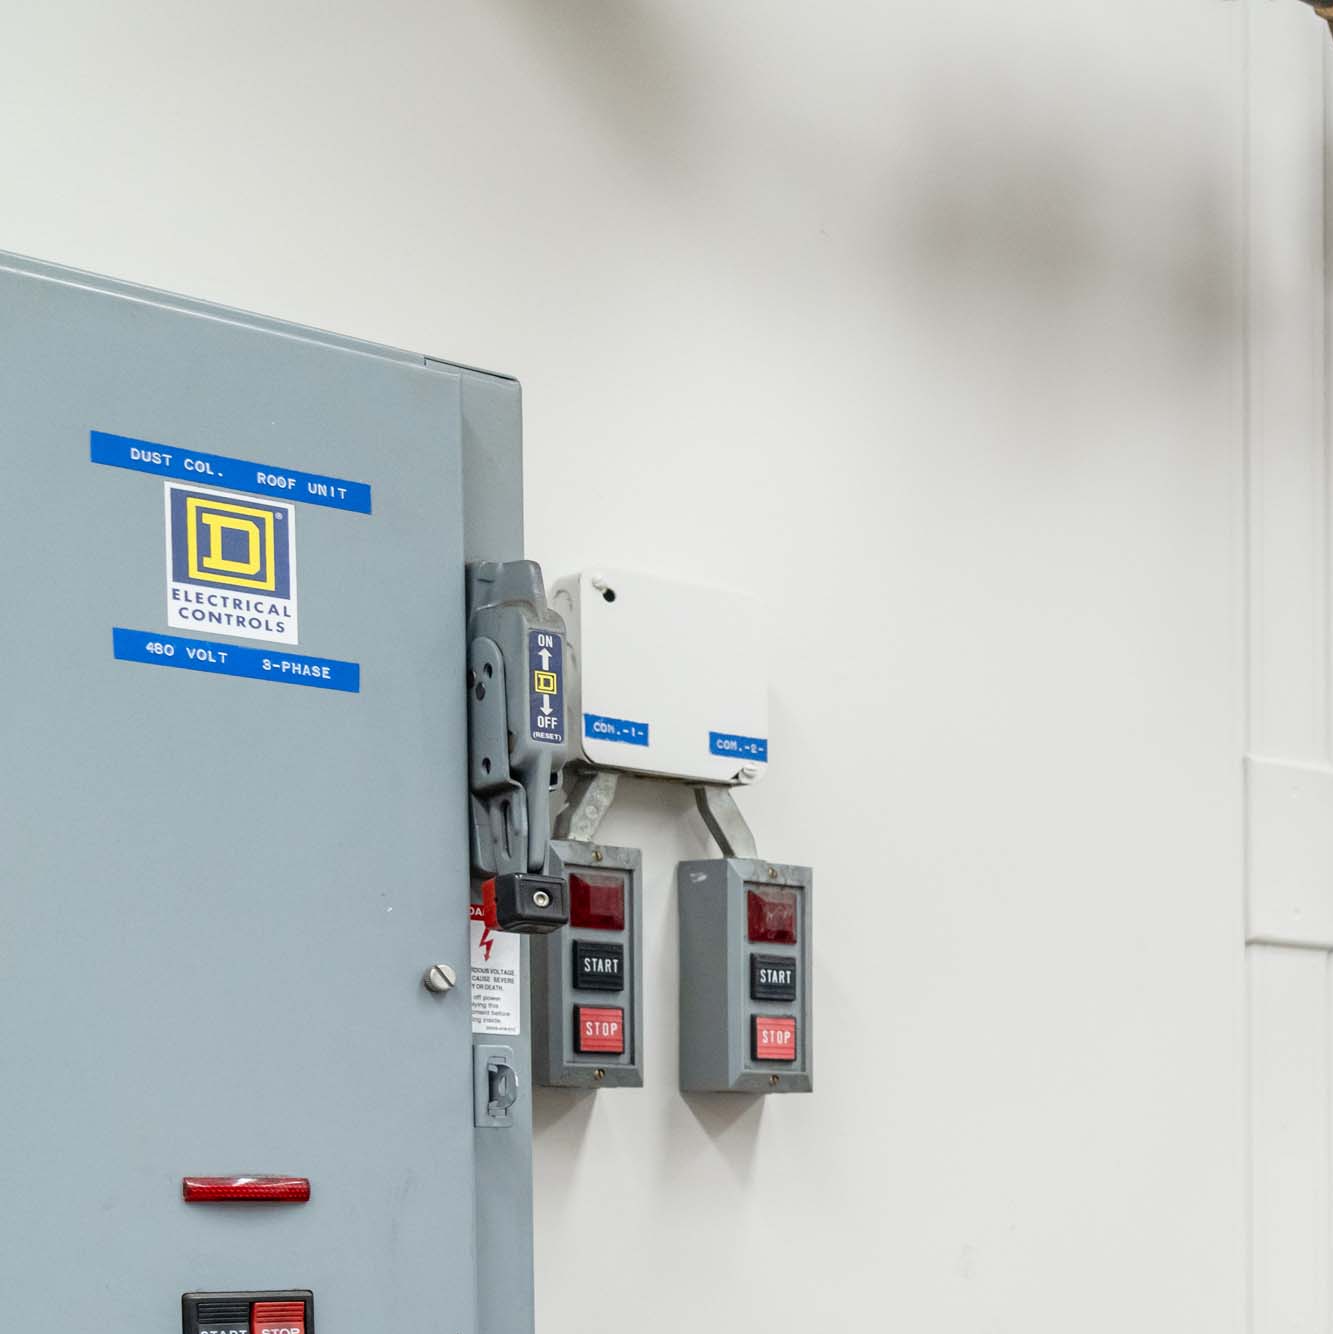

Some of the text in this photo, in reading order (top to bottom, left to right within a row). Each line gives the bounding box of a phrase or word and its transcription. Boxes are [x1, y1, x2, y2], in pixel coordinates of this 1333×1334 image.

[131, 447, 347, 499] DUST COL. ROOF UNIT
[202, 512, 260, 576] D
[172, 588, 292, 618] ELECTRICAL
[178, 607, 285, 633] CONTROLS
[538, 634, 553, 648] ON
[145, 641, 331, 679] 480 VOLT 3-PHASE
[538, 674, 554, 691] D
[537, 716, 558, 729] OFF
[532, 731, 562, 741] (RESET)
[490, 968, 514, 976] VOLTAGE
[584, 958, 619, 973] START
[760, 968, 792, 984] START
[586, 1021, 618, 1037] STOP
[762, 1030, 791, 1044] STOP
